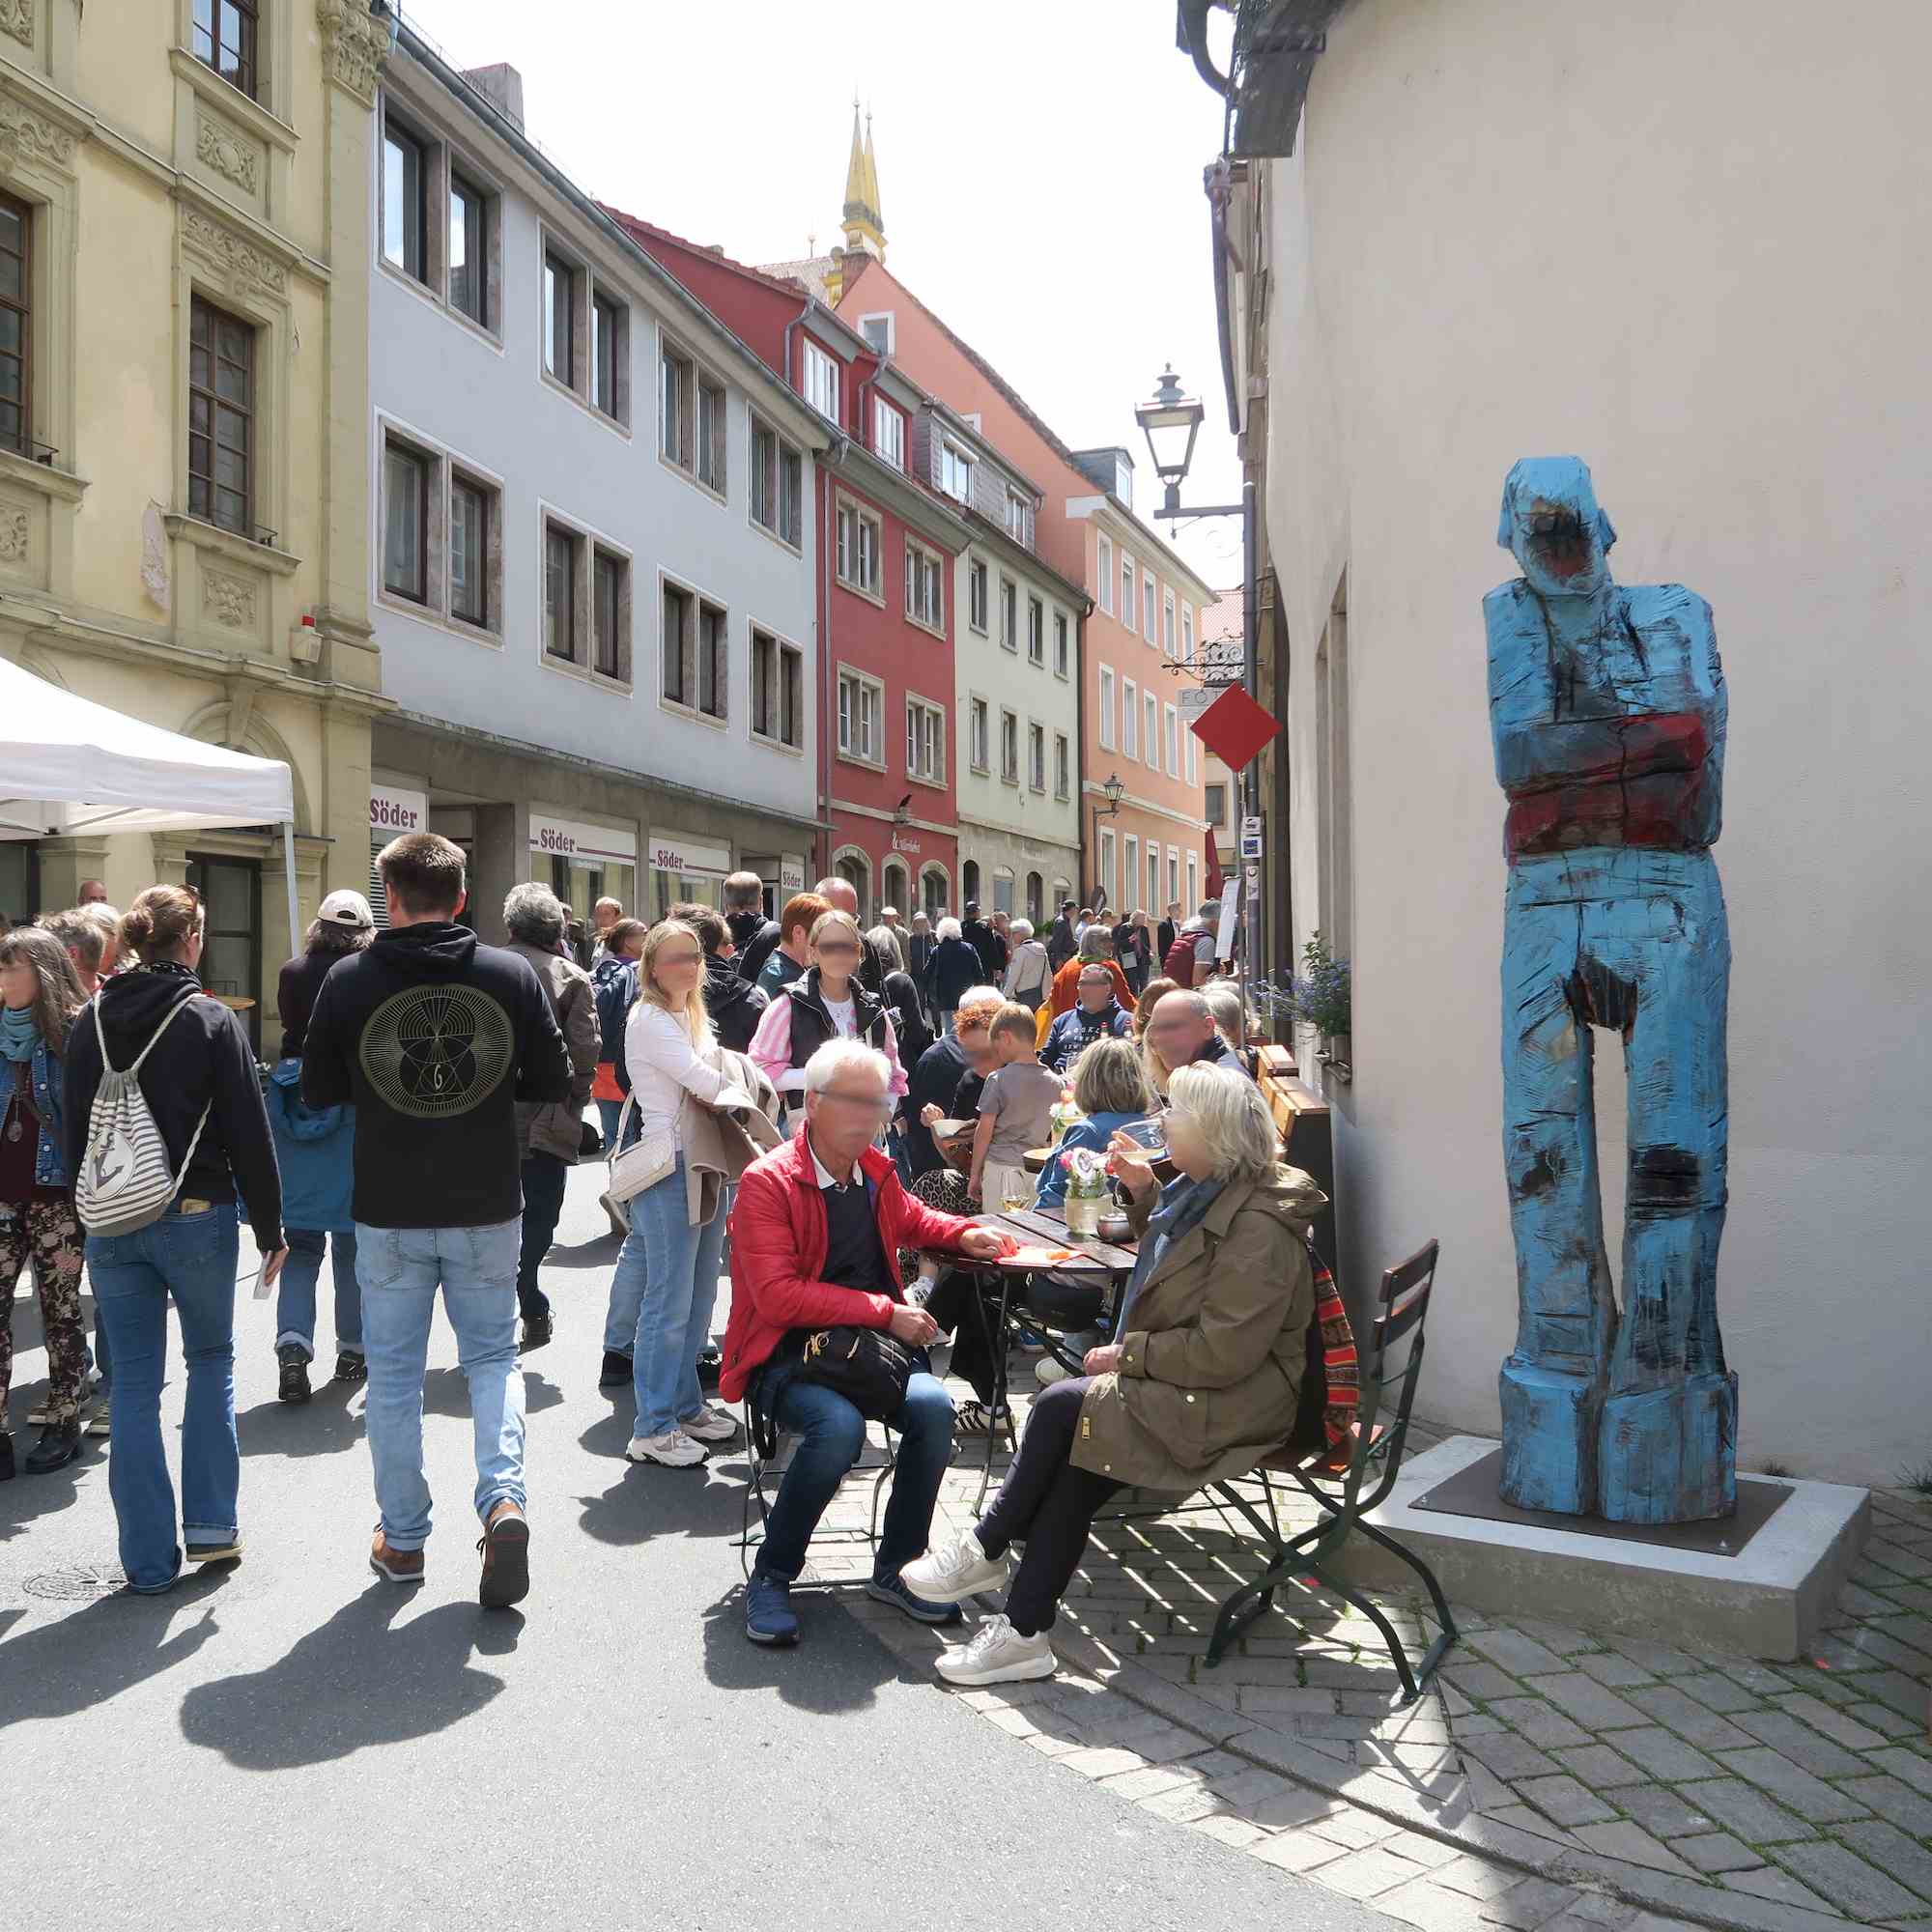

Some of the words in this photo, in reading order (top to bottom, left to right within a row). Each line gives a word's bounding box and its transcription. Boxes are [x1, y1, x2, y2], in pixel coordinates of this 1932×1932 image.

[1181, 690, 1224, 704] FOT
[370, 798, 417, 828] Söder
[541, 828, 575, 852] Söder
[658, 849, 683, 869] Söder
